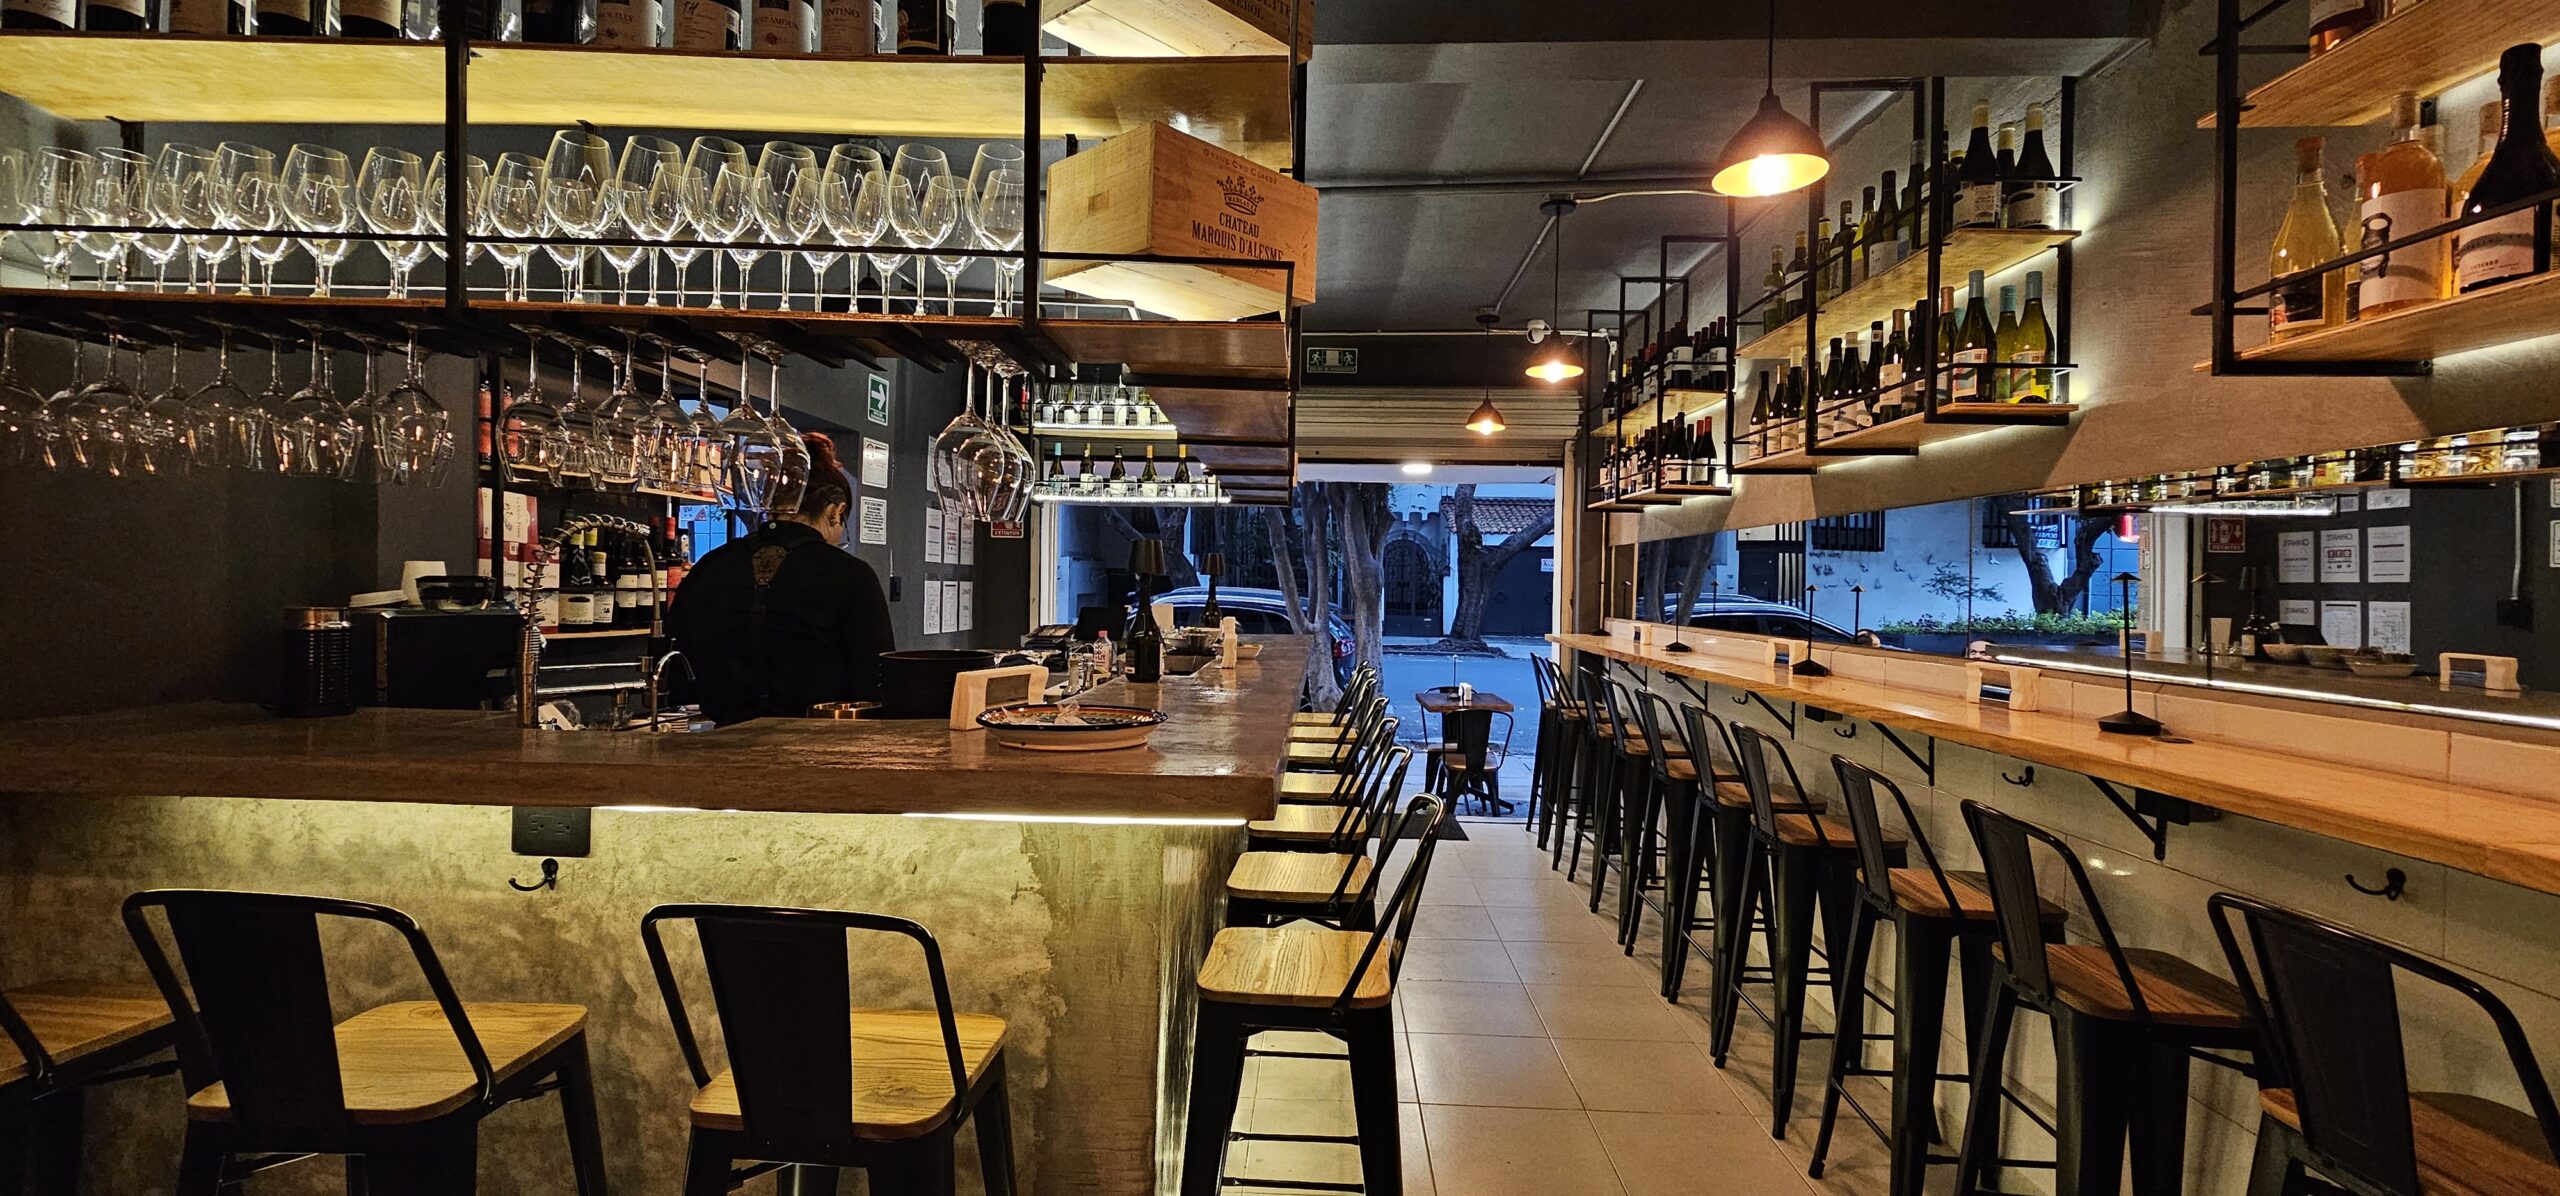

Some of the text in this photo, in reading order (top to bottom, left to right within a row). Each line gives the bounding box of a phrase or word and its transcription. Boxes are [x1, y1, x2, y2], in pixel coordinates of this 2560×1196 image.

[1192, 220, 1237, 251] MARQUIS
[1239, 237, 1284, 261] D'ALESME
[1219, 212, 1260, 238] CHATEAU
